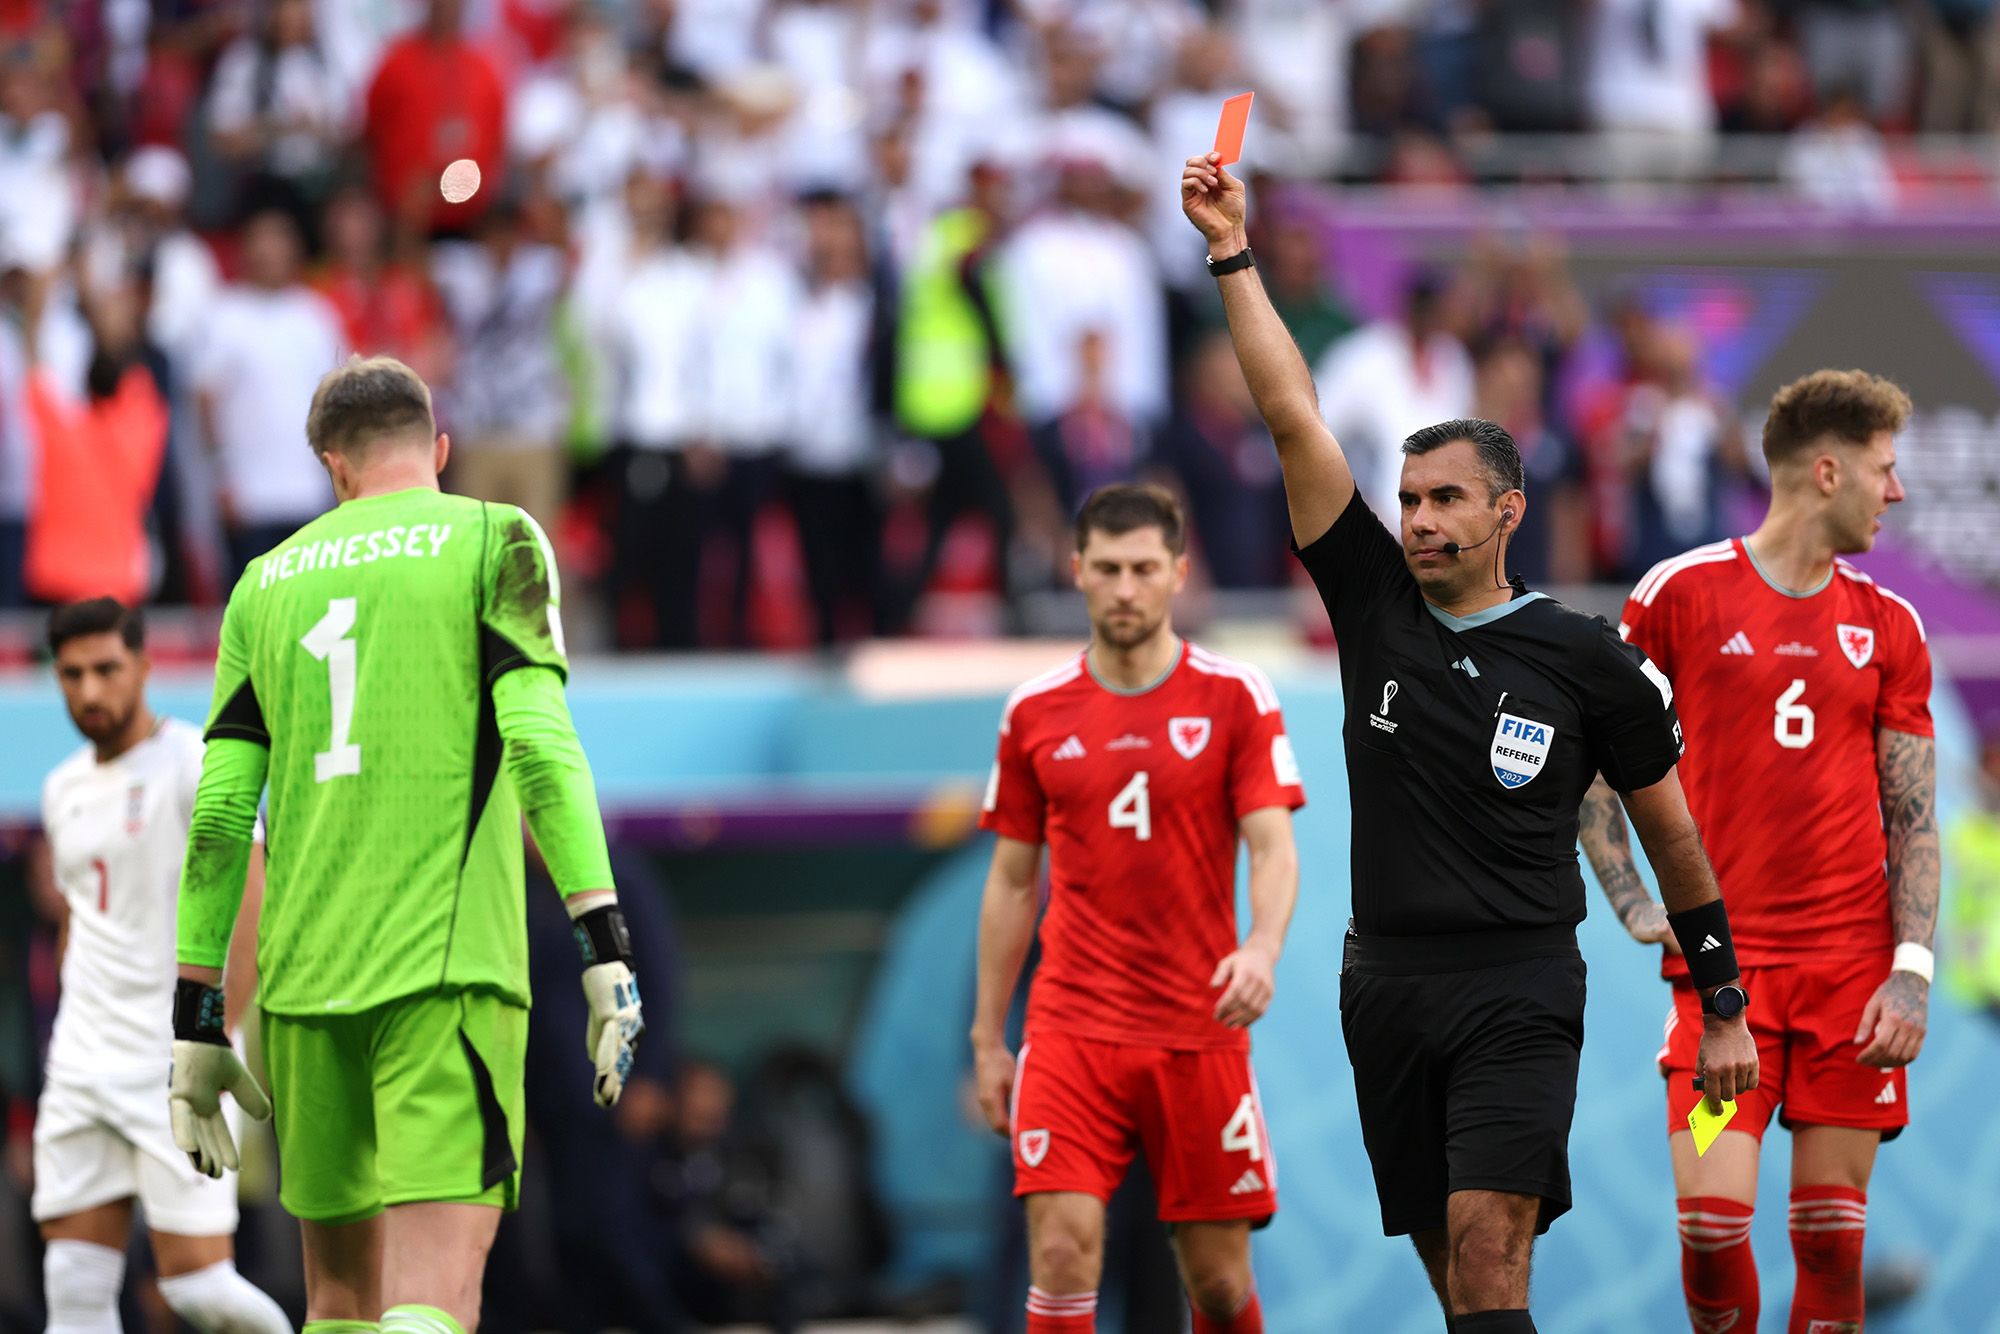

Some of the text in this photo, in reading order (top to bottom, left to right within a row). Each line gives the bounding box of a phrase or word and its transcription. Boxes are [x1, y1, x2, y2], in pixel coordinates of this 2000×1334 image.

[260, 524, 451, 589] HENNESSEY
[300, 597, 361, 784] 1
[1773, 679, 1815, 749] 6
[1496, 746, 1541, 765] REFEREE
[1502, 719, 1545, 745] FIFA
[1108, 771, 1150, 841] 4
[1501, 771, 1522, 783] 2022
[1221, 1092, 1261, 1161] 4
